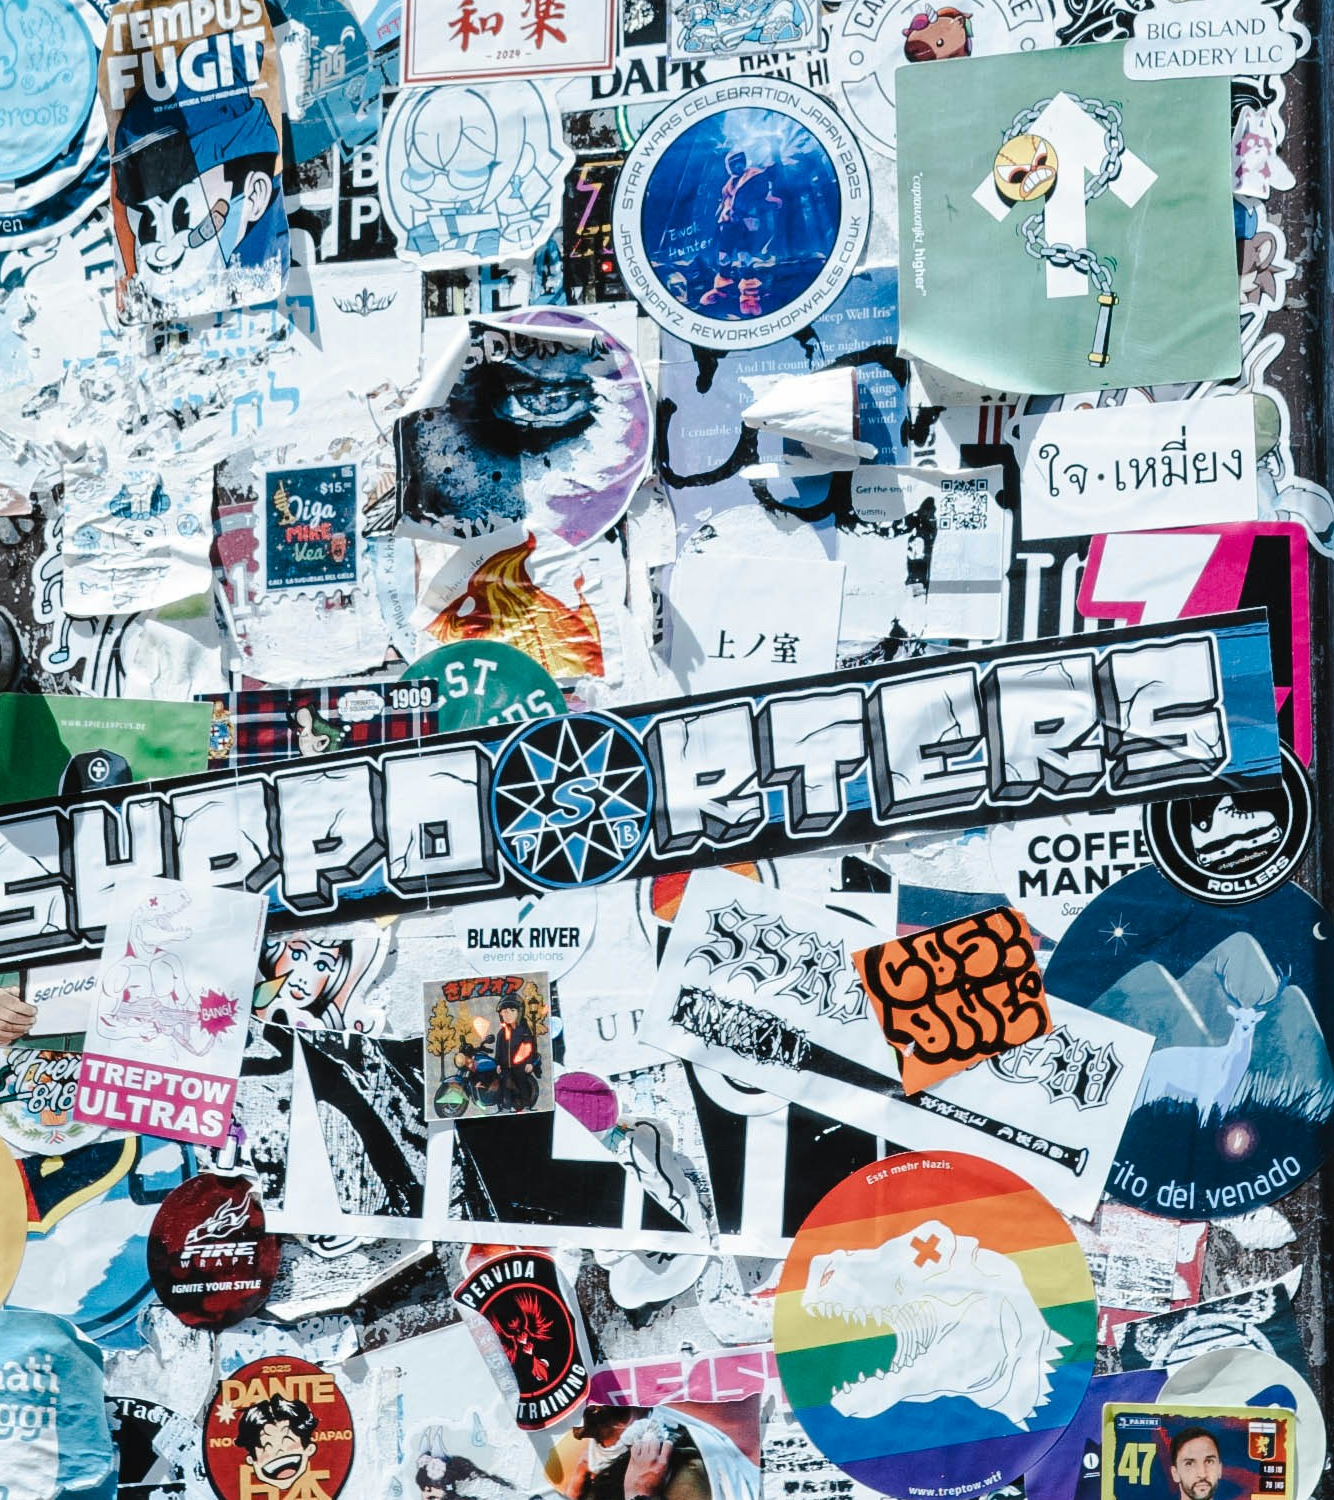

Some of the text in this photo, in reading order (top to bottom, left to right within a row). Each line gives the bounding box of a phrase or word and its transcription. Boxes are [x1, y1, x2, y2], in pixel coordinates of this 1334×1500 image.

[1147, 18, 1266, 41] BIG ISLAND
[106, 28, 268, 110] FUGIT
[1134, 44, 1284, 70] MEADERY LLC
[622, 86, 862, 210] STAR WARS CELEBRATION JAPAN 2025
[390, 687, 432, 709] 1909
[1208, 855, 1290, 894] ROLLERS
[468, 926, 580, 949] BLACK RIVER
[483, 951, 564, 962] event solutions
[202, 1004, 233, 1021] BANG!
[87, 1058, 231, 1105] TREPTOW
[79, 1089, 225, 1138] ULTRAS
[866, 1159, 954, 1185] Esst mehr Nazis.
[1157, 1154, 1302, 1210] del venado
[180, 1241, 258, 1259] FIRE
[172, 1279, 262, 1294] IGNITE YOUR STYLE
[262, 1363, 292, 1374] 2025
[221, 1373, 336, 1405] DANTE
[1117, 1442, 1157, 1487] 47
[908, 1470, 1004, 1499] www.treptow.wtf
